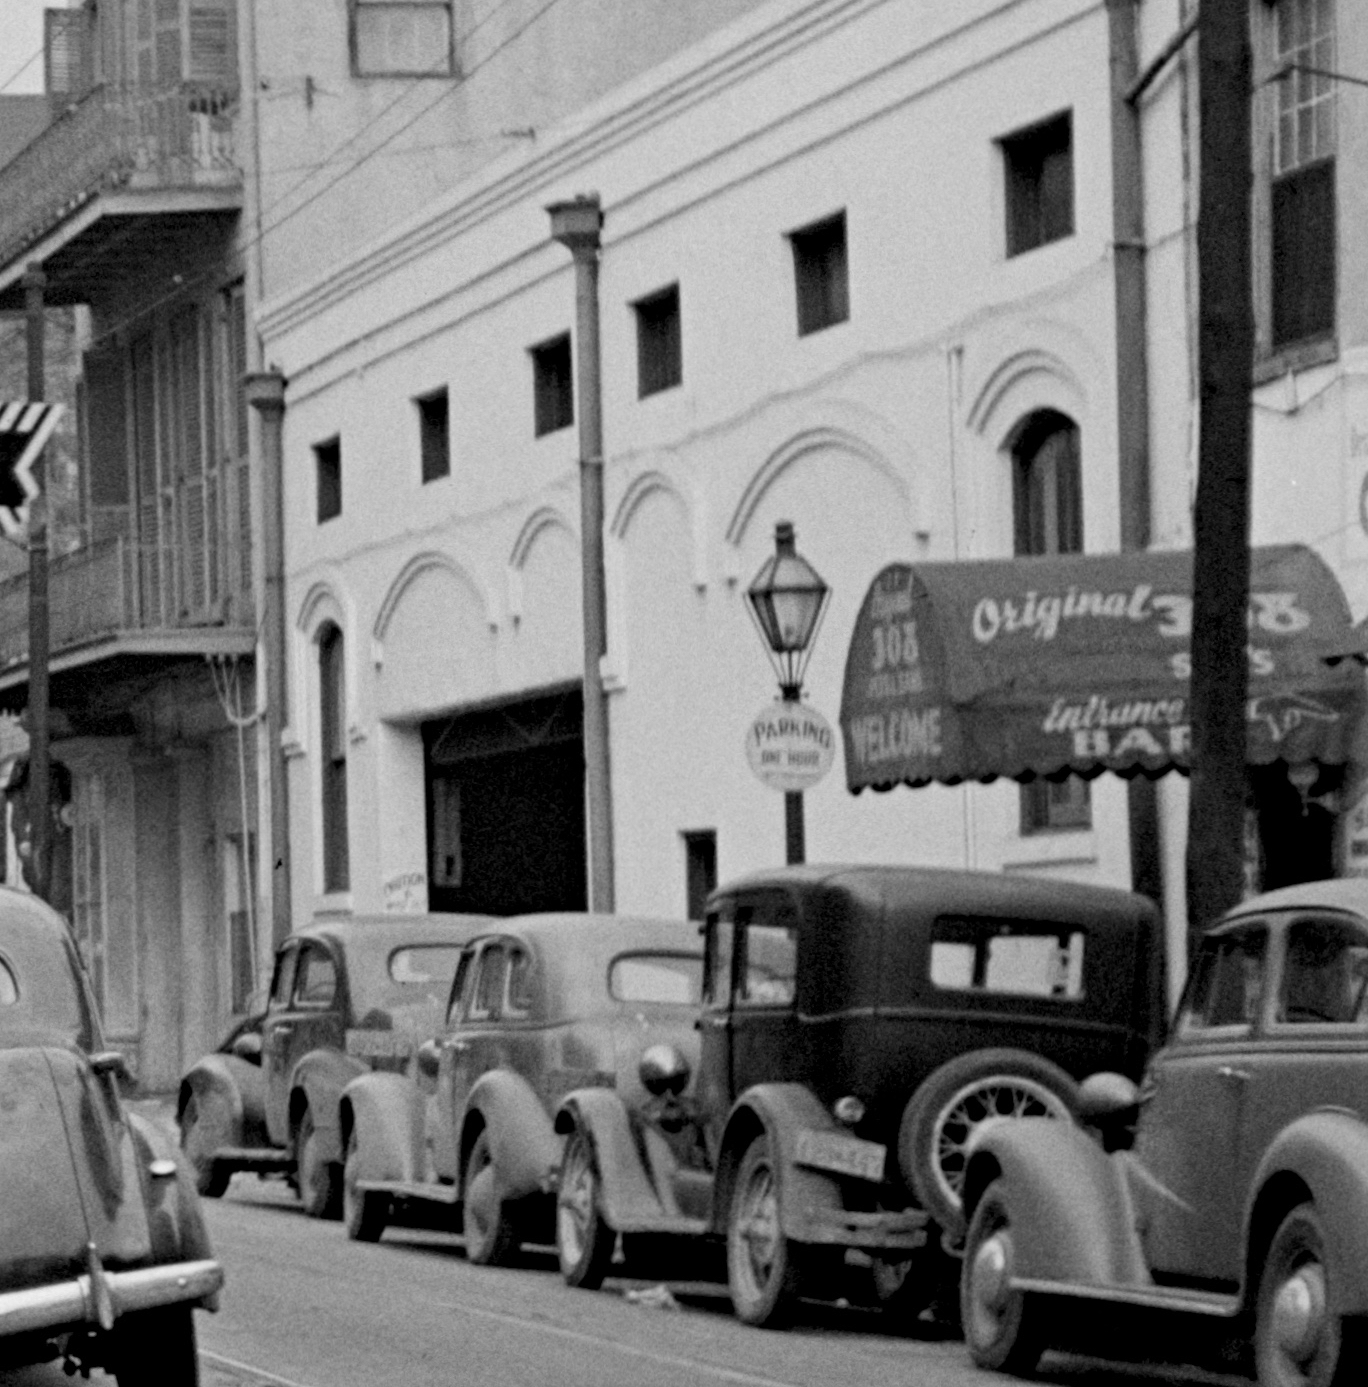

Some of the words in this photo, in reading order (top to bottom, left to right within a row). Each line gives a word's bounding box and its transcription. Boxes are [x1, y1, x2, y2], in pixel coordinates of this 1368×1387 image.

[971, 583, 1153, 643] Original
[753, 717, 831, 749] PARKING
[1042, 694, 1185, 733] Entrance
